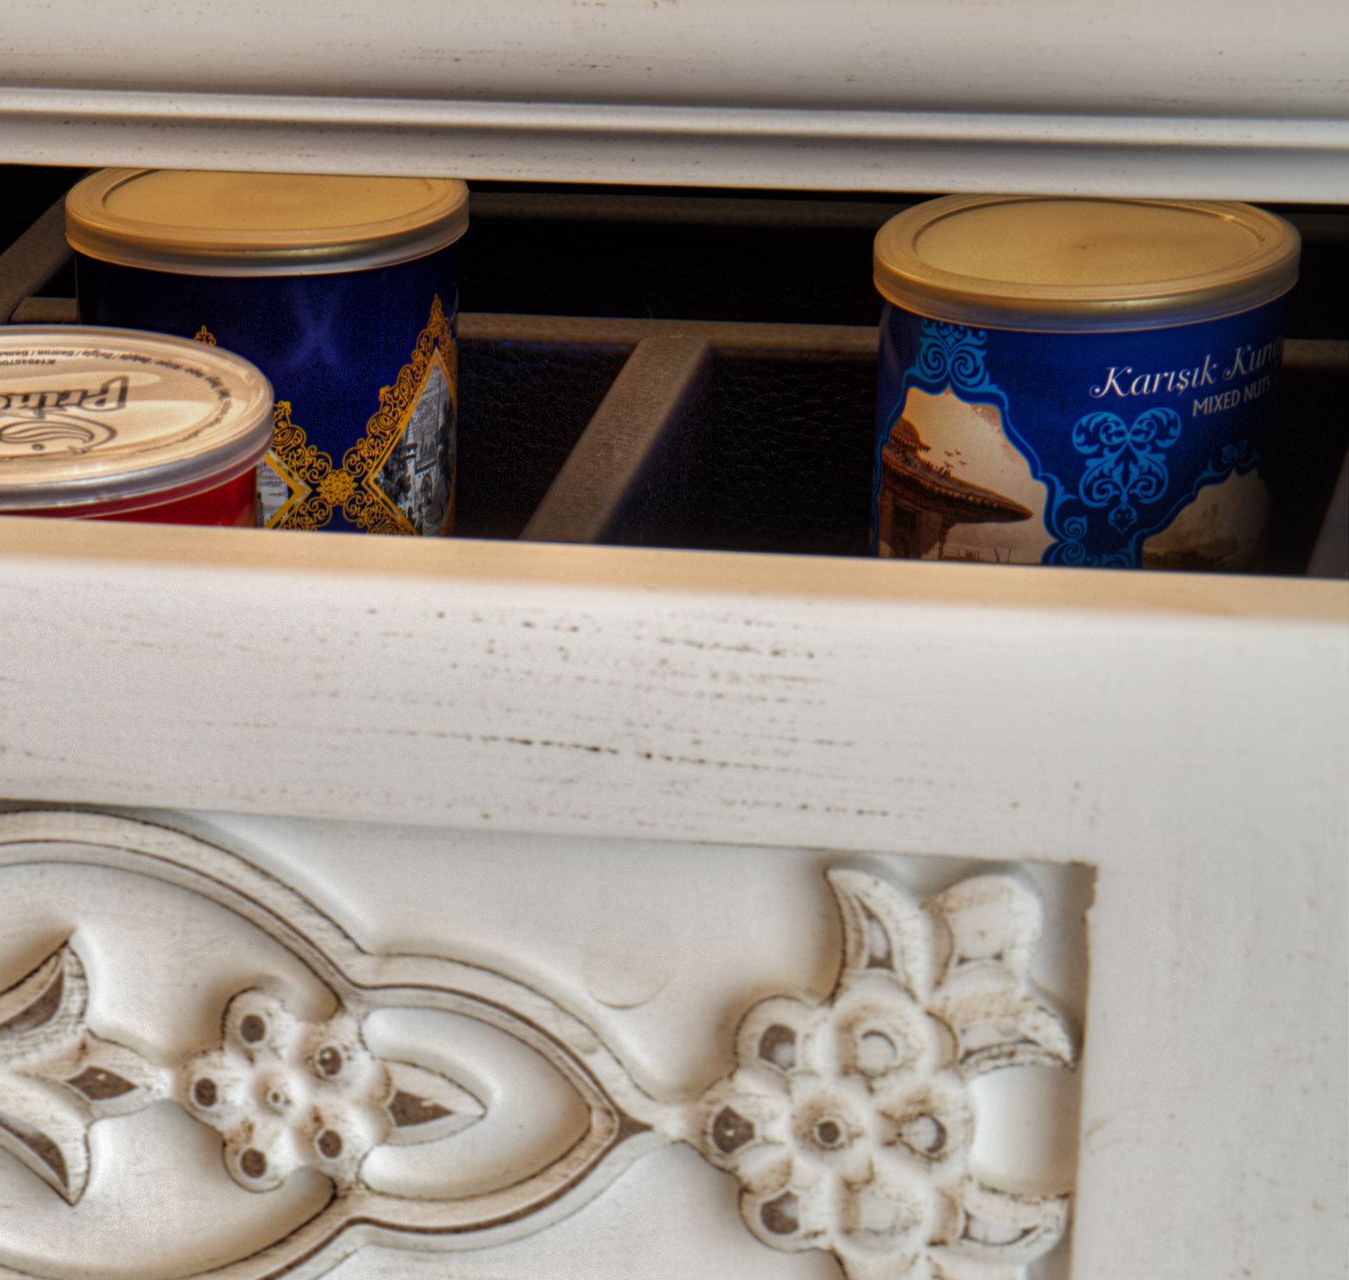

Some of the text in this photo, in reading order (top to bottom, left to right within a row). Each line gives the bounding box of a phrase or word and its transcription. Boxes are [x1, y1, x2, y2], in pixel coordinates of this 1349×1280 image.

[1090, 354, 1218, 398] Karışık
[1193, 375, 1271, 417] MIXED NUTS
